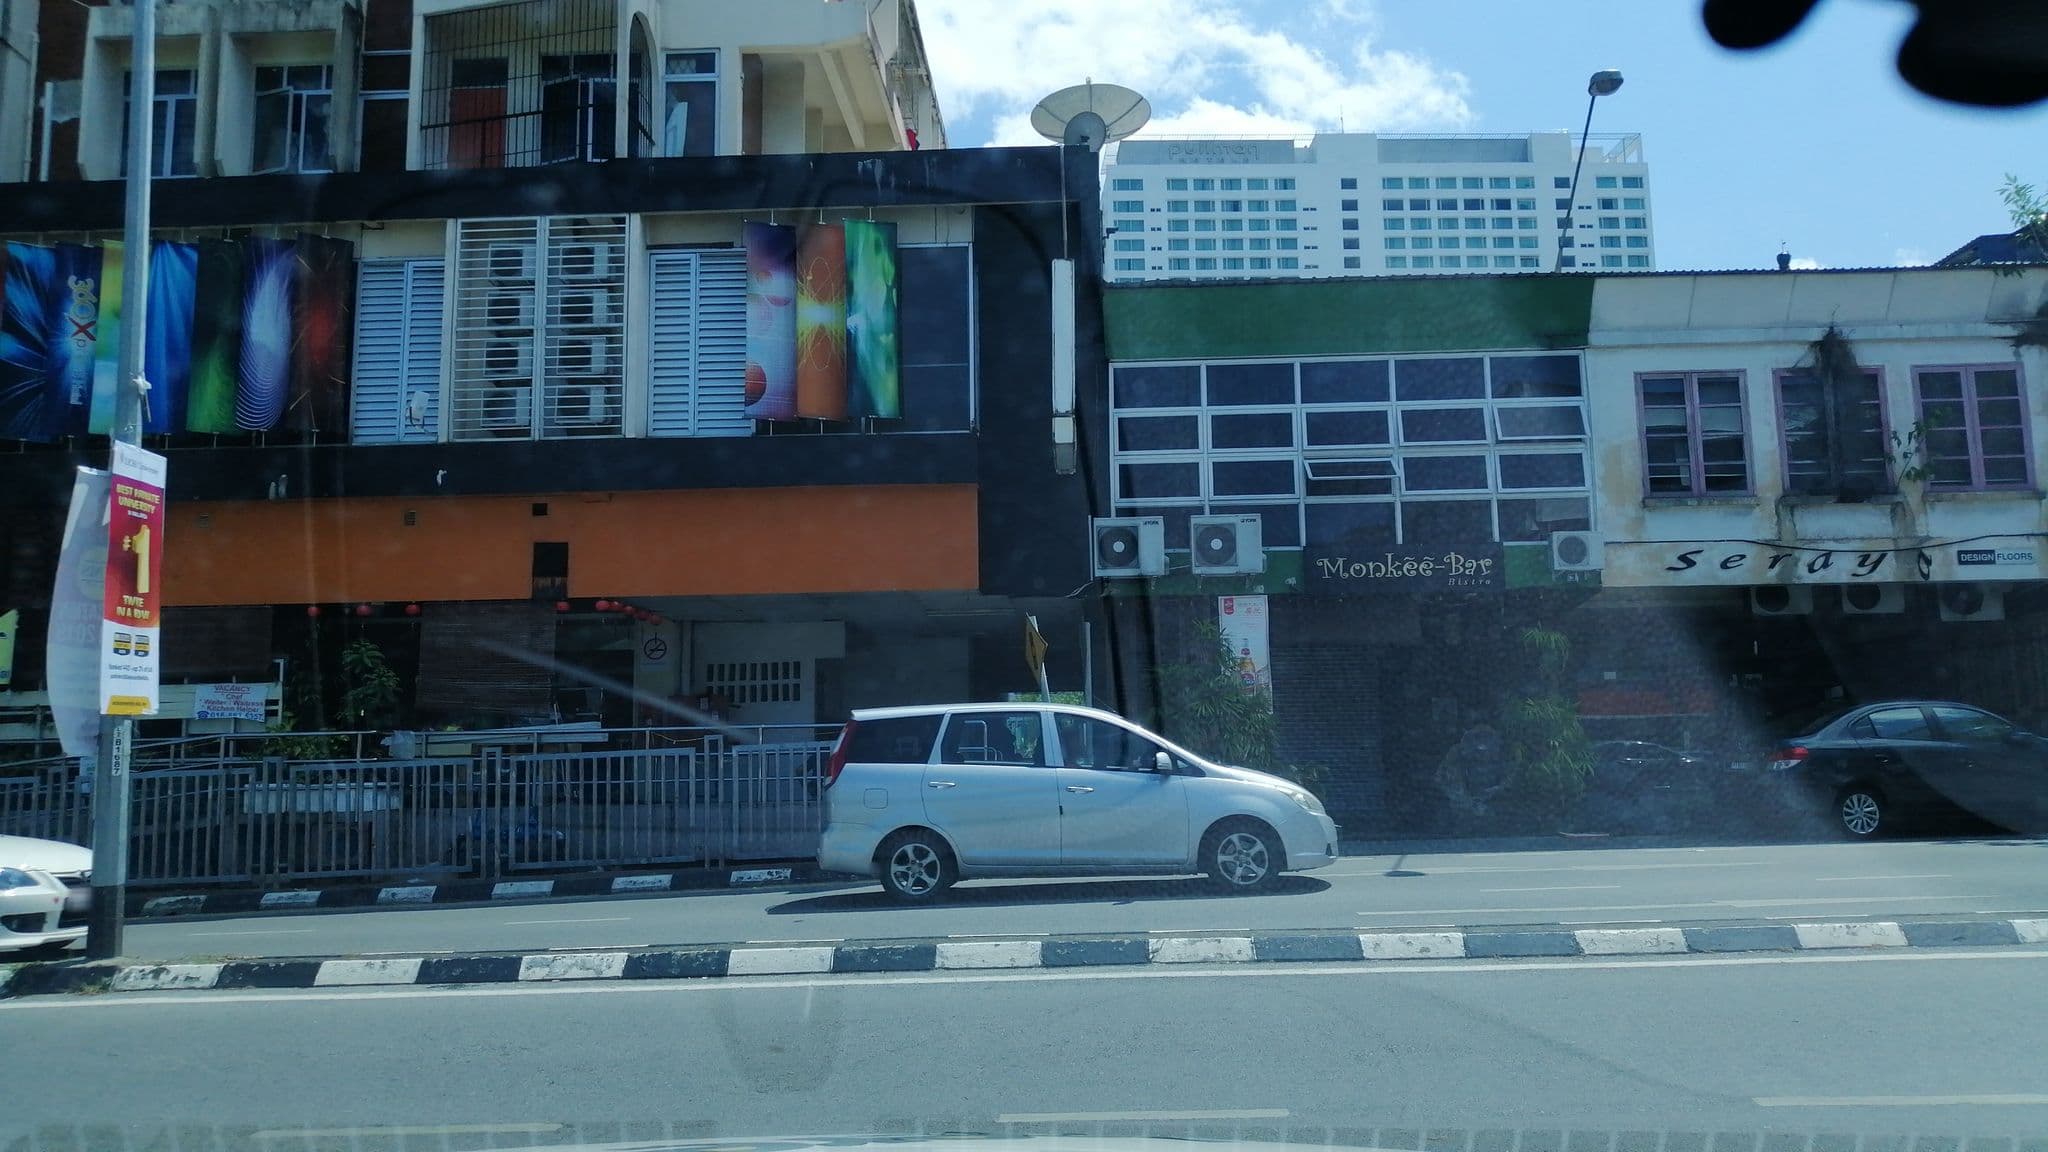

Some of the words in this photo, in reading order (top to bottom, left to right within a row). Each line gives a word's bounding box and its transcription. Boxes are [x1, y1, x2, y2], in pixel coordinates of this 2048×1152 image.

[1960, 553, 1995, 562] DESIGN
[1997, 552, 2033, 561] FLOORS
[126, 608, 132, 617] A
